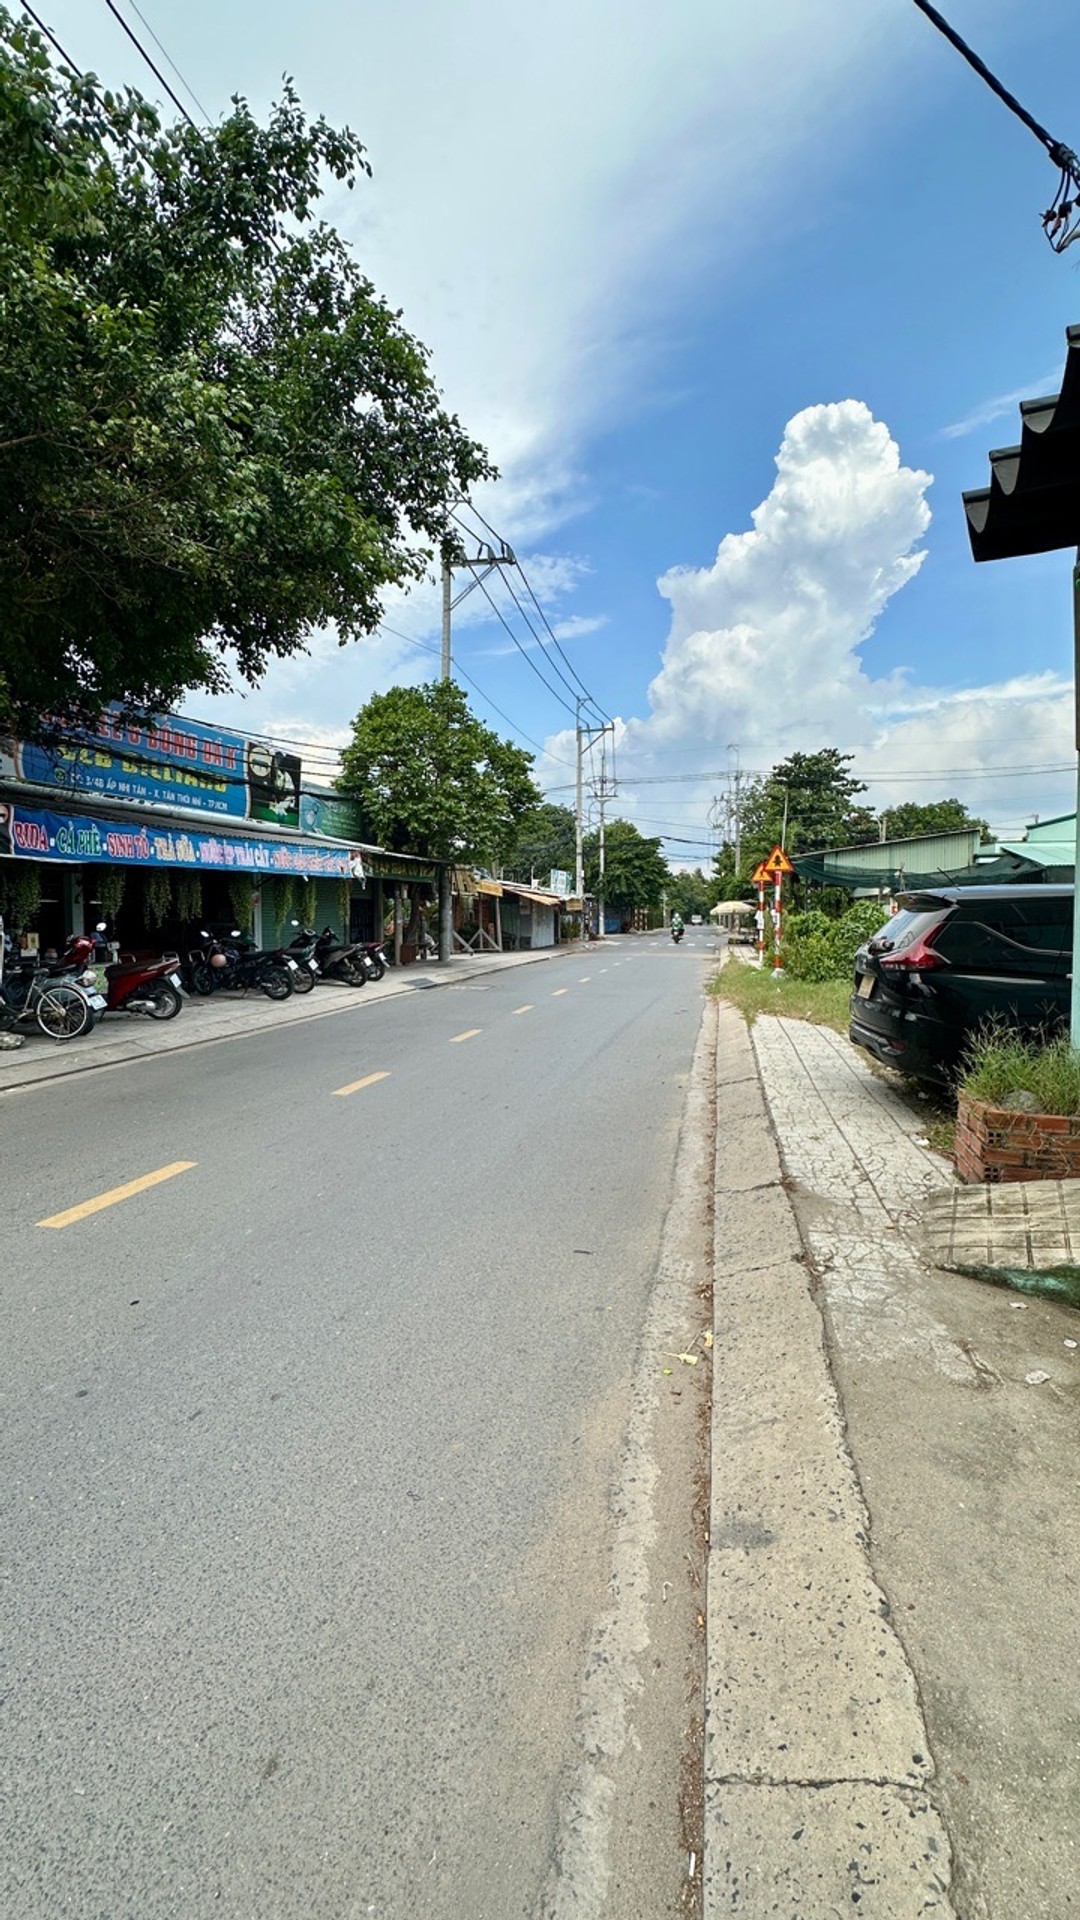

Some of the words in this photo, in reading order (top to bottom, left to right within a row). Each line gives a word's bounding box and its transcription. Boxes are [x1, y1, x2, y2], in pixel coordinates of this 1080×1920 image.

[147, 722, 198, 760] BÓNG
[13, 821, 49, 851] BIDA
[77, 823, 102, 856] PHÊ
[107, 832, 133, 858] SINH
